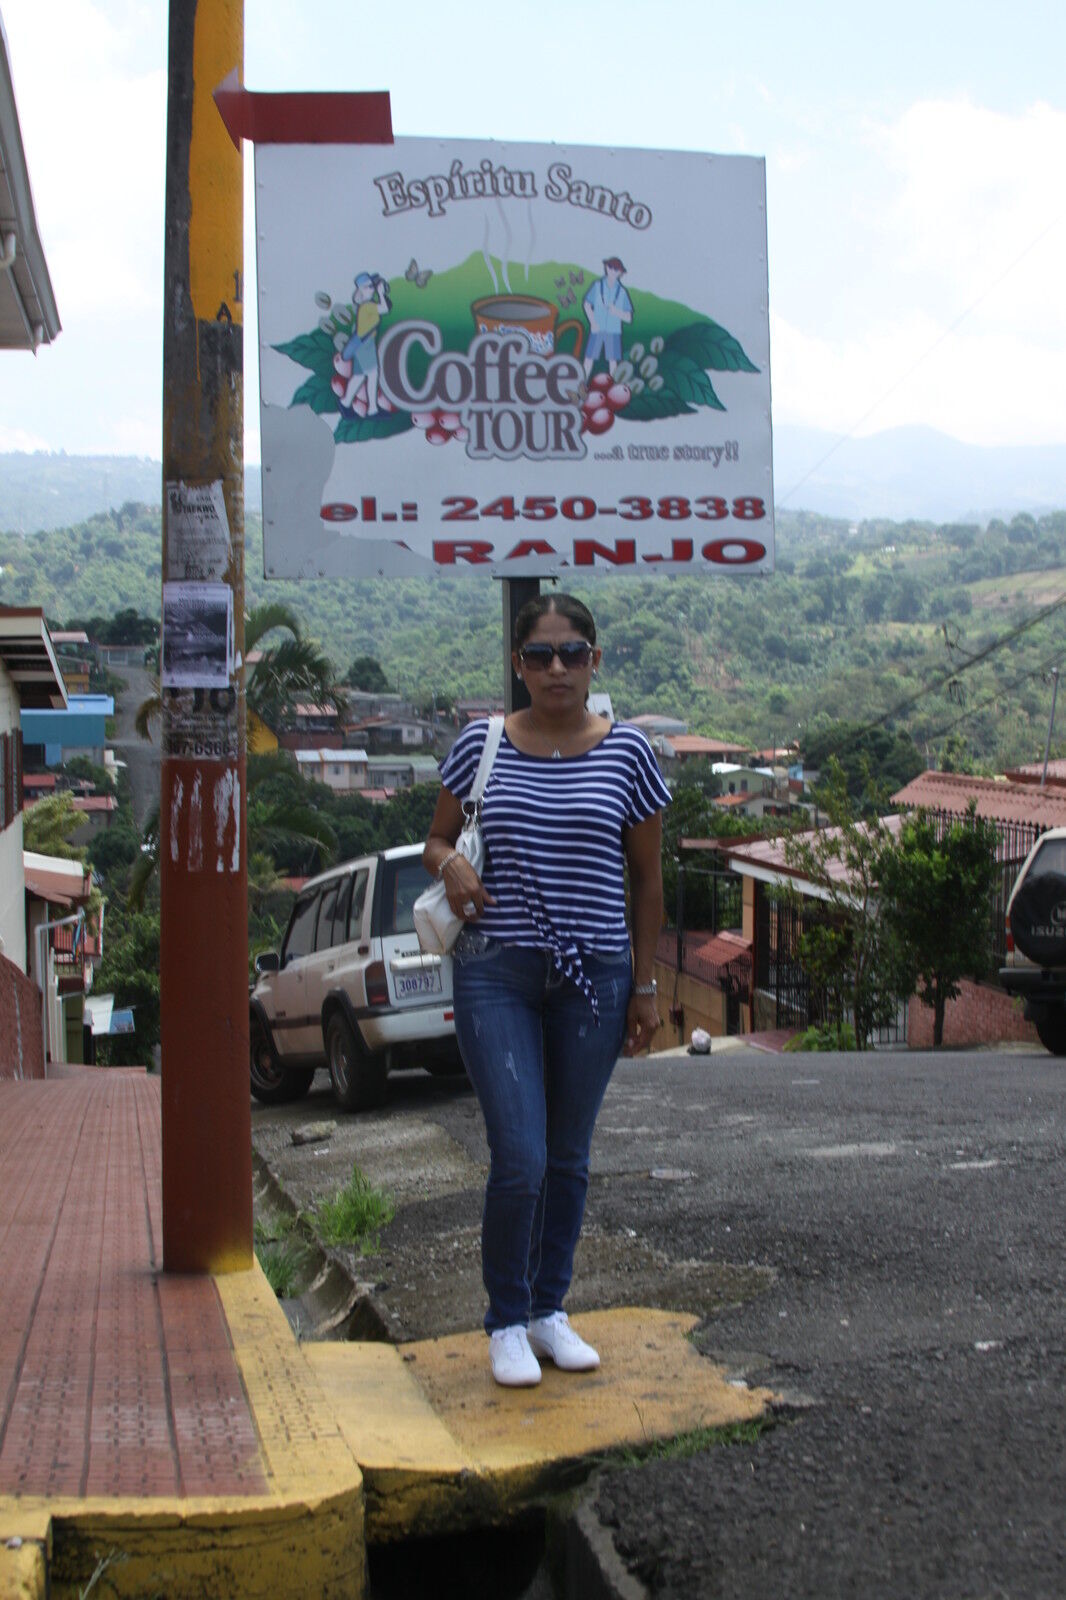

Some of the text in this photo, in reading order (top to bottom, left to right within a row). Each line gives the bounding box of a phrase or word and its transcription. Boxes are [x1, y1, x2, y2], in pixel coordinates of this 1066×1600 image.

[373, 159, 653, 231] Espíritu Santo
[382, 326, 581, 406] Coffee
[467, 409, 582, 452] TOUR
[627, 443, 670, 462] true
[440, 495, 767, 522] 2450-3838
[1031, 925, 1066, 938] ISUZ
